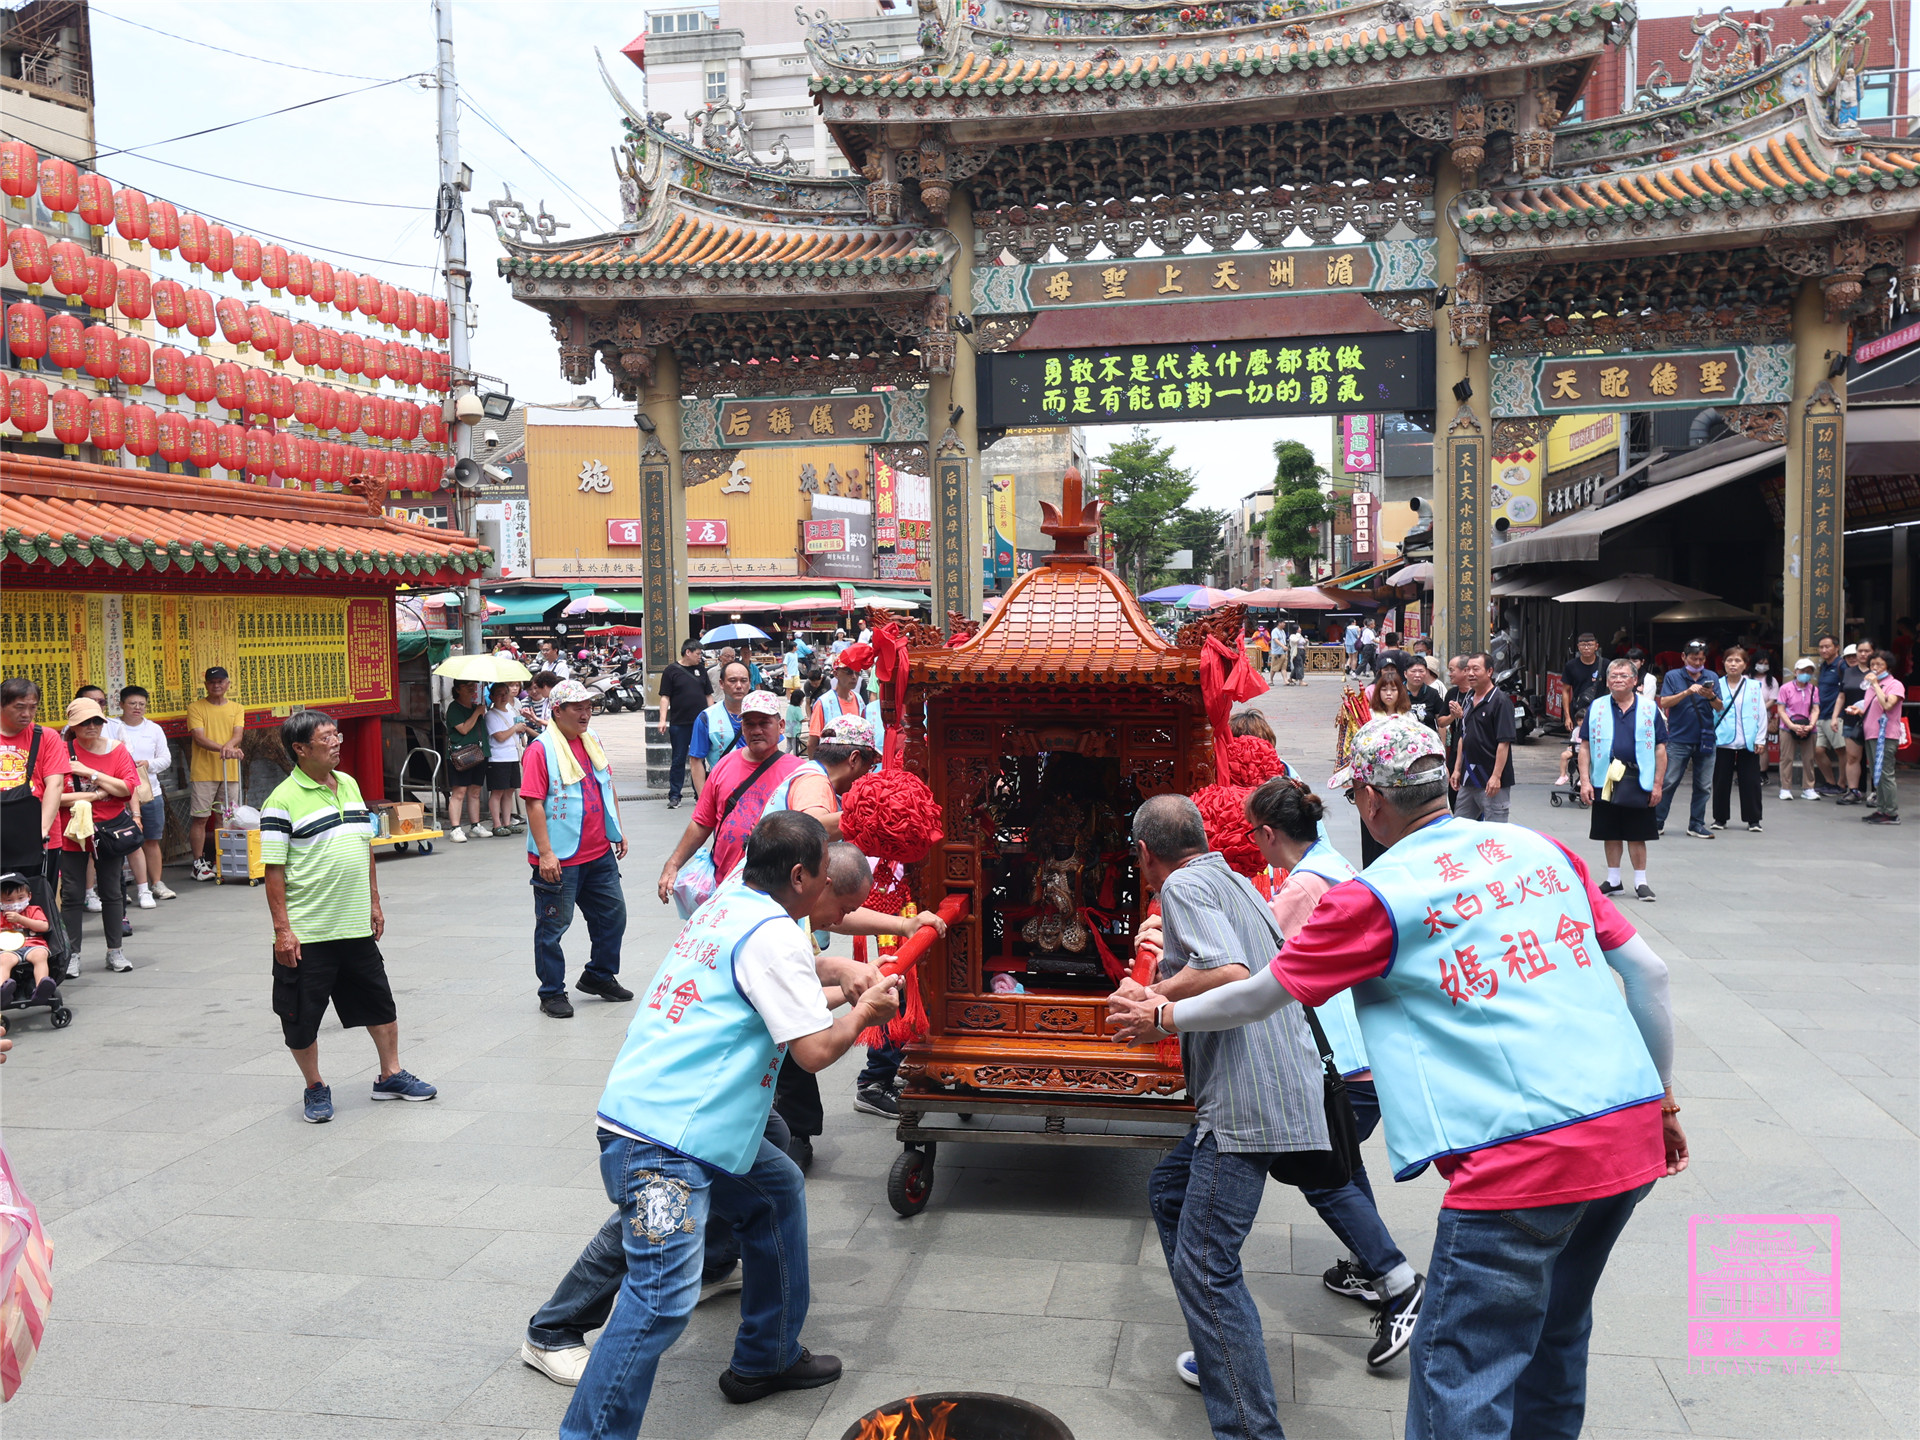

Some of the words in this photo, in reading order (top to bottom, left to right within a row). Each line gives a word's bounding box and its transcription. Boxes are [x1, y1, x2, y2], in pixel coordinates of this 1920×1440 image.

[1042, 344, 1366, 388] 勇敢不是代表什麼都敢做
[1042, 374, 1365, 414] 而是有能面對一切的勇氣
[1433, 838, 1512, 883] 基隆
[1422, 866, 1571, 939] 太白里火號
[1438, 913, 1592, 1007] 媽祖會
